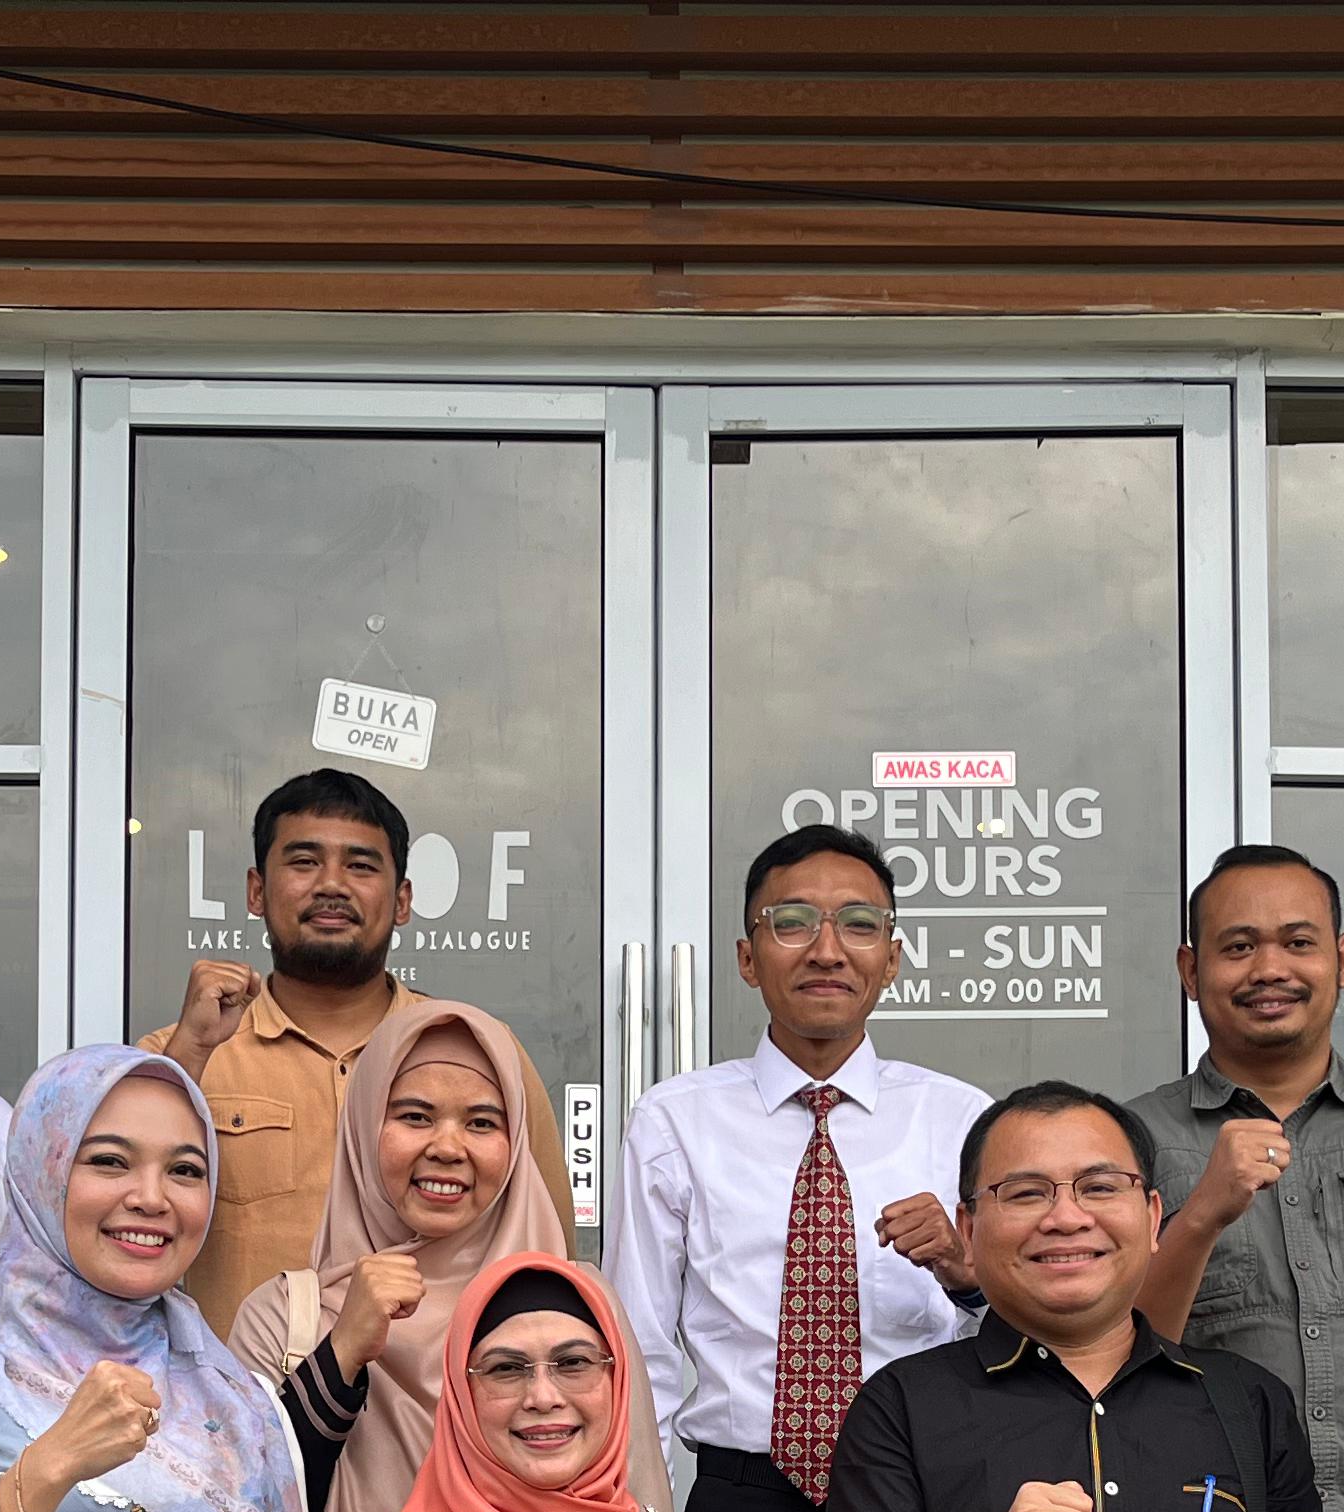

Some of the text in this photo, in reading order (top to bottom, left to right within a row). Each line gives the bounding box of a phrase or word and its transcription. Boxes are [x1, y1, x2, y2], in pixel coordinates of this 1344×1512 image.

[333, 691, 419, 731] BUKA
[347, 729, 398, 752] OPEN
[883, 760, 1004, 779] AWAS KACA
[781, 787, 1102, 840] OPENING
[189, 830, 530, 921] LOF
[882, 845, 1062, 897] OURS
[415, 931, 531, 950] DIALOGUE
[983, 925, 1102, 969] SUN
[878, 979, 930, 1003] AM
[1054, 978, 1101, 1002] PM
[572, 1100, 592, 1188] PUSH
